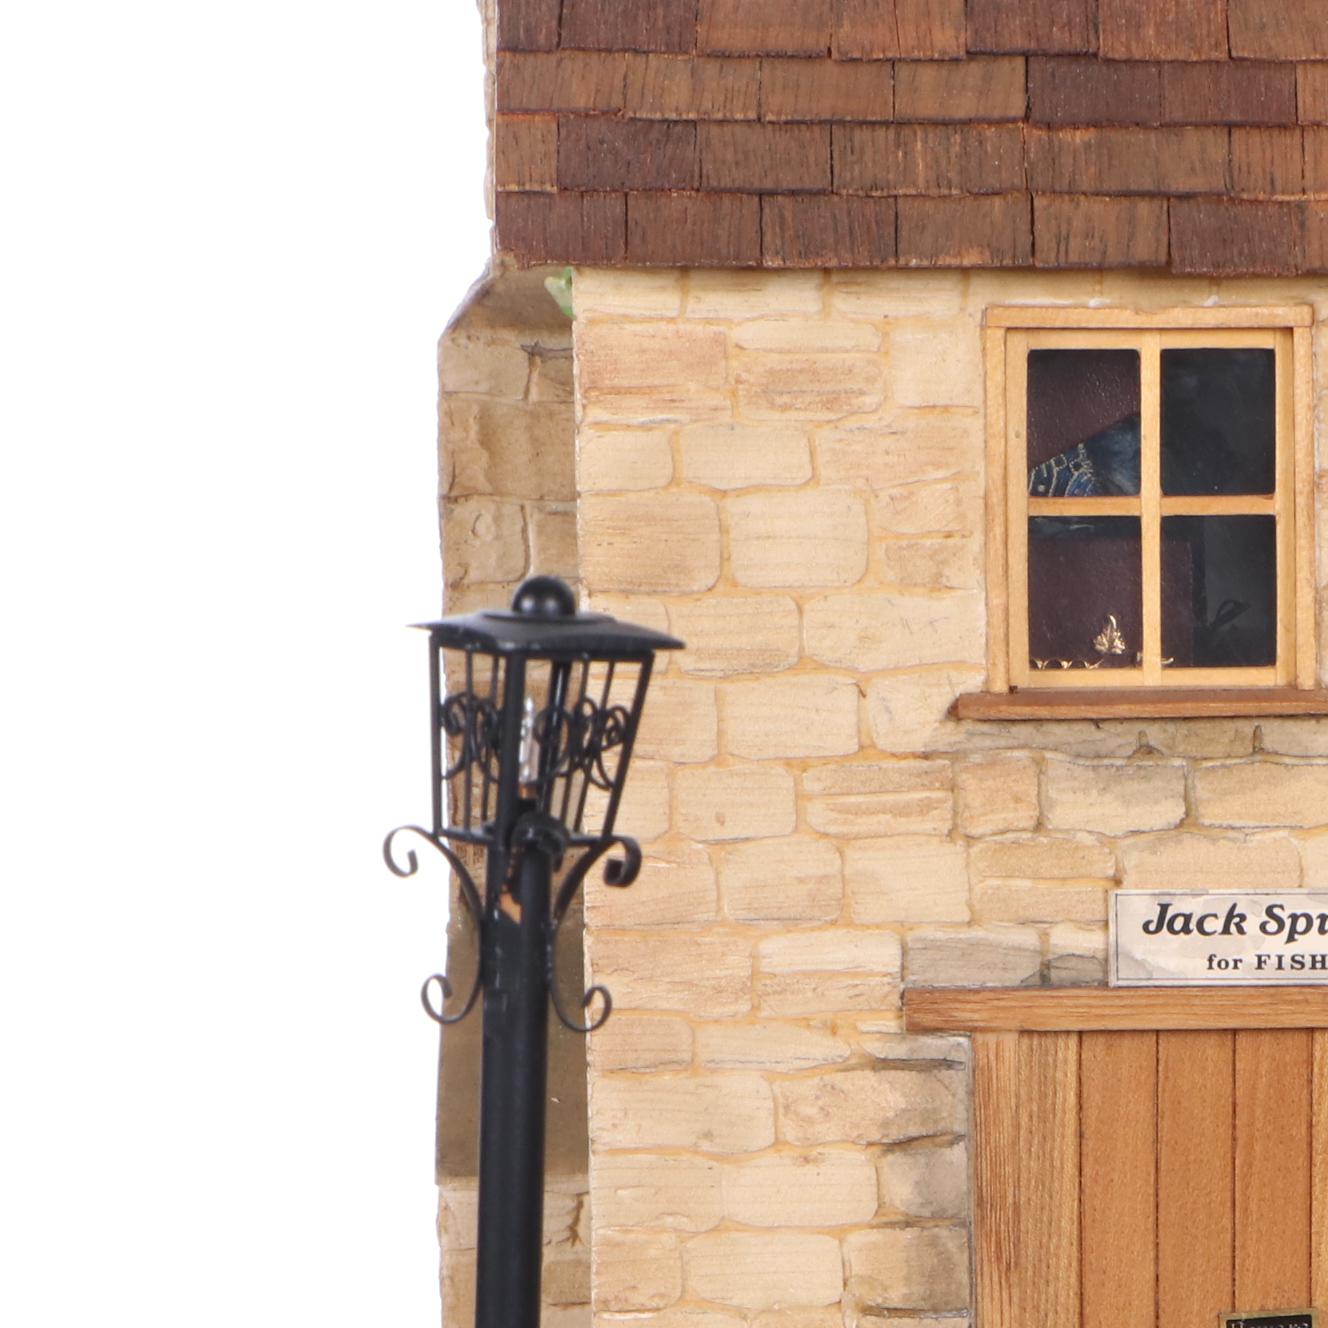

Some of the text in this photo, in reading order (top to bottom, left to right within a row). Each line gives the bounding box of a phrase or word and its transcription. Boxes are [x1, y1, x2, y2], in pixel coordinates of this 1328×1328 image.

[1142, 902, 1248, 936] Jack
[1206, 953, 1328, 971] for FISH
